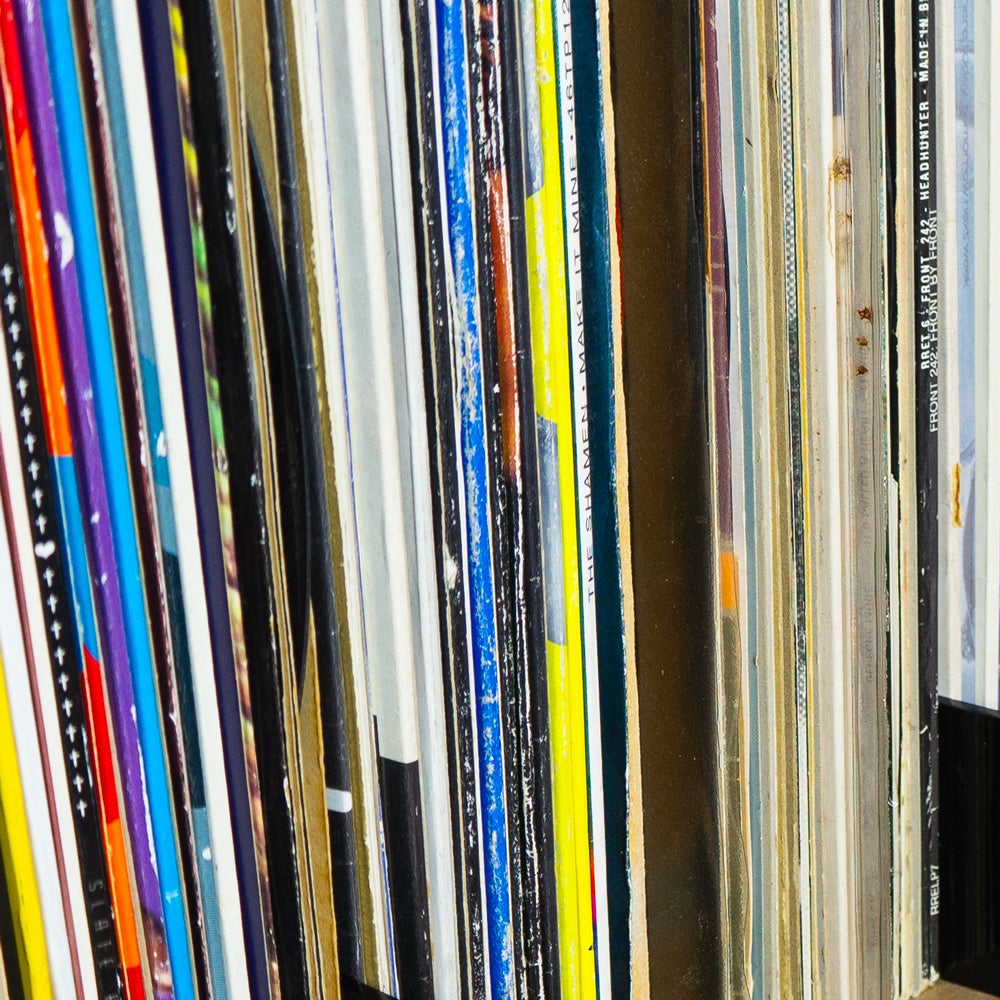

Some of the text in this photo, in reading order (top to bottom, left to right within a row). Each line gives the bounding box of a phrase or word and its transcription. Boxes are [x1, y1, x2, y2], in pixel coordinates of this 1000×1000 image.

[919, 41, 929, 82] MADE
[919, 101, 930, 200] HEADHUNTER
[569, 155, 580, 233] MINE
[920, 219, 930, 244] 242
[929, 207, 938, 258] FRONT
[573, 248, 581, 274] IT
[920, 256, 930, 302] FRONT
[929, 264, 938, 285] BY
[575, 290, 586, 374] MAKE
[929, 292, 938, 341] FRONT
[929, 382, 938, 432] FRONT
[580, 406, 592, 532] SHAMEN
[586, 549, 595, 602] THE
